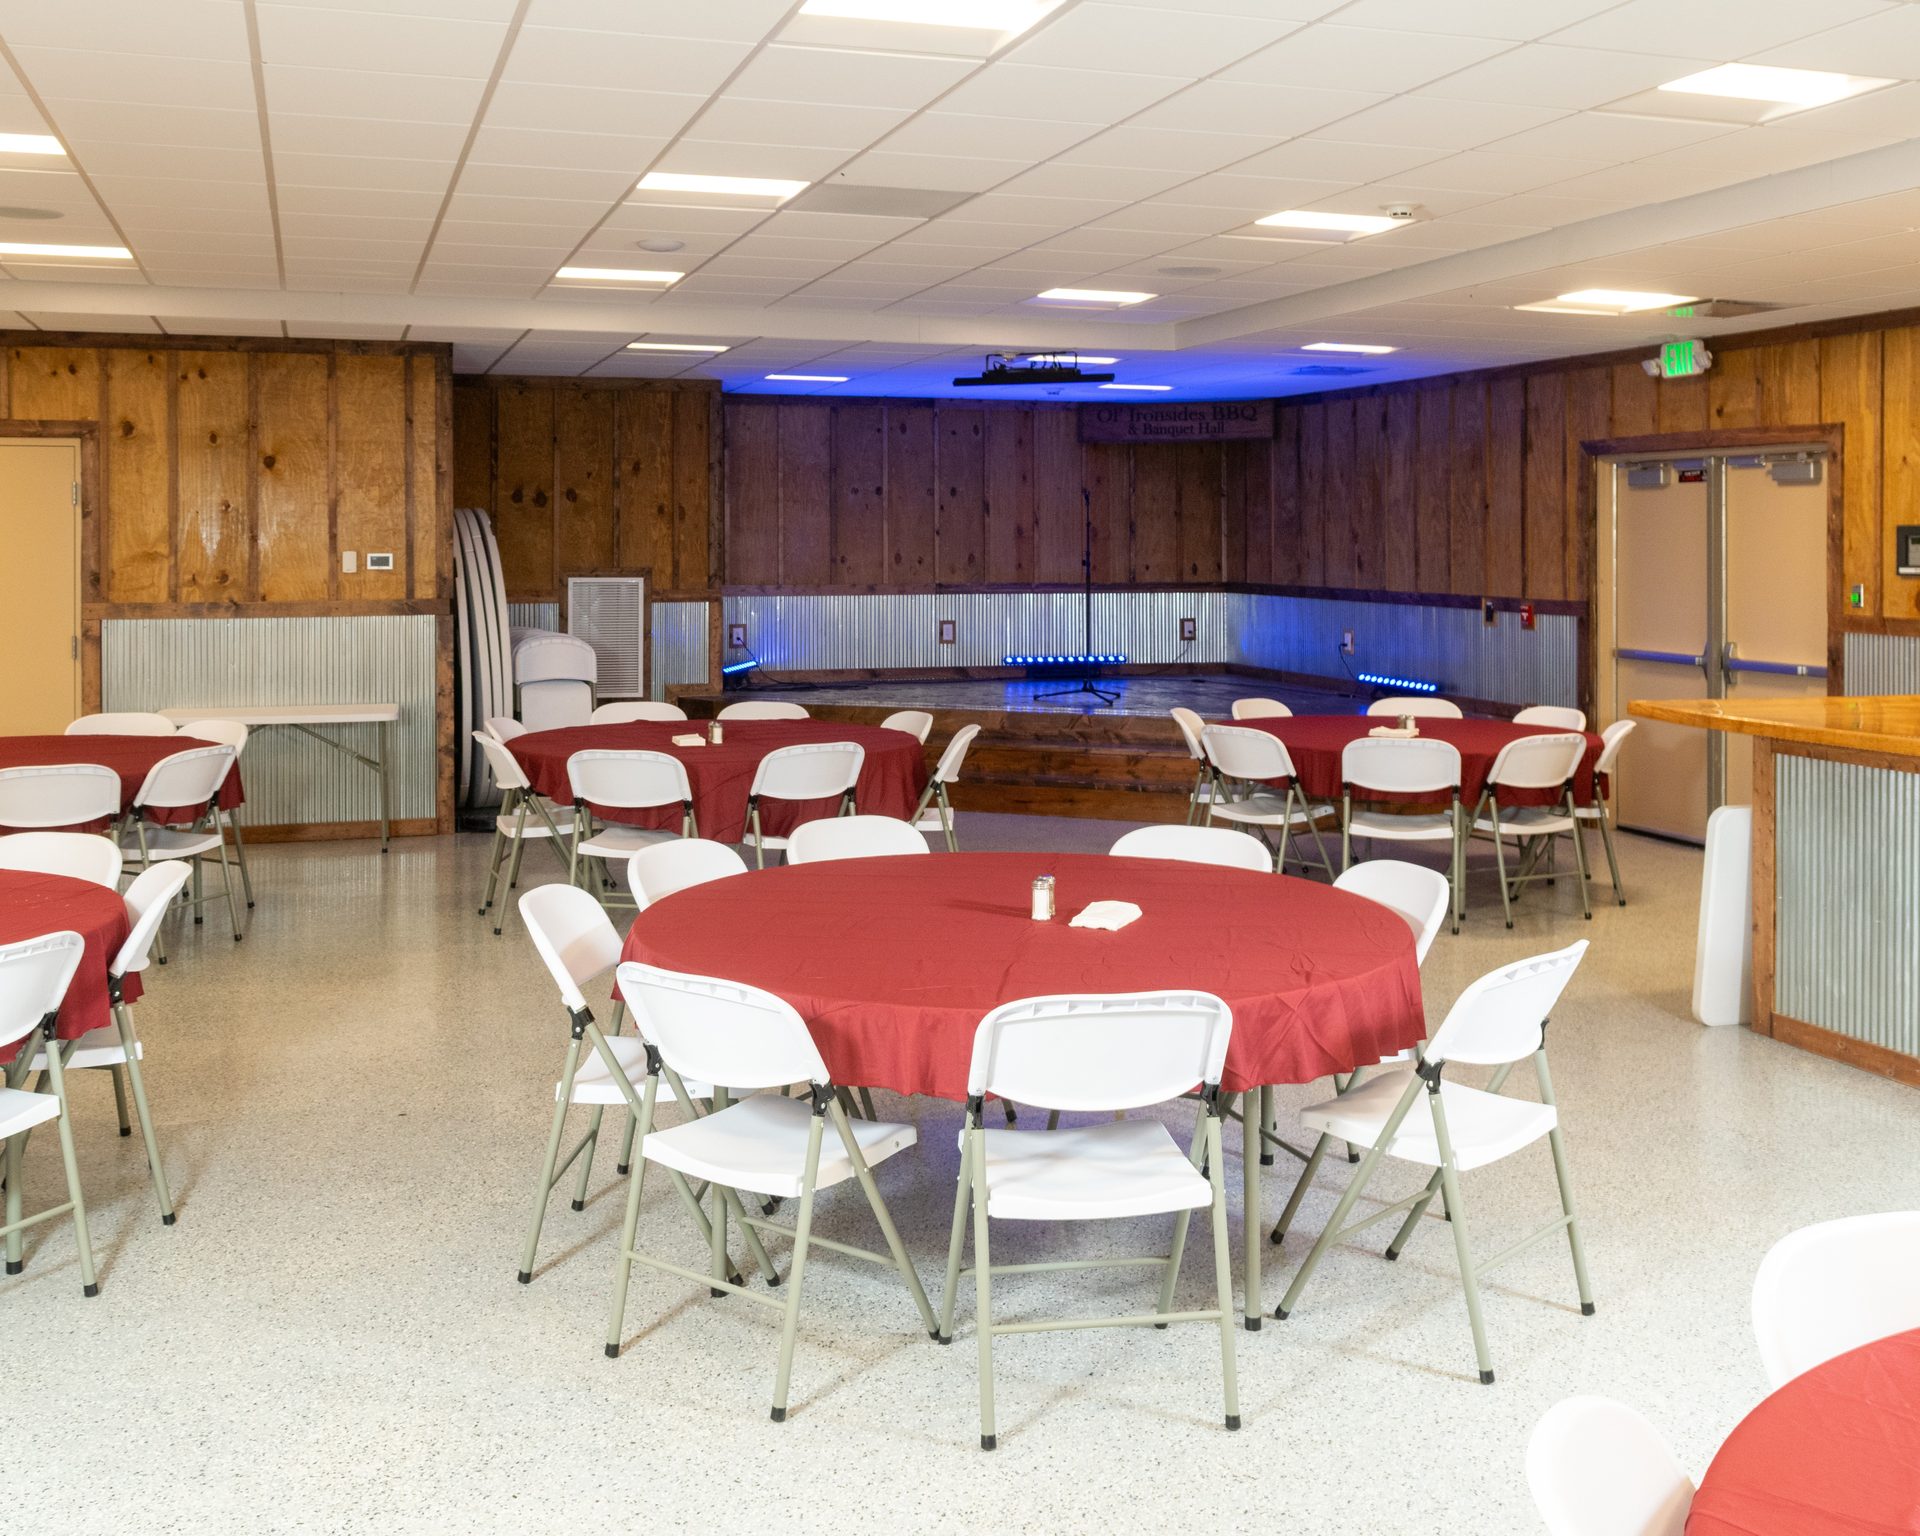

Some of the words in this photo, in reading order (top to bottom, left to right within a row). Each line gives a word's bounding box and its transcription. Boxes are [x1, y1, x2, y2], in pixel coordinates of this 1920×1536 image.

[1666, 341, 1694, 377] EXIT
[1129, 405, 1206, 422] Ironsides
[1212, 405, 1257, 421] BBQ
[1128, 423, 1137, 435] &
[1143, 422, 1194, 437] Banquet
[1199, 421, 1225, 434] Hall
